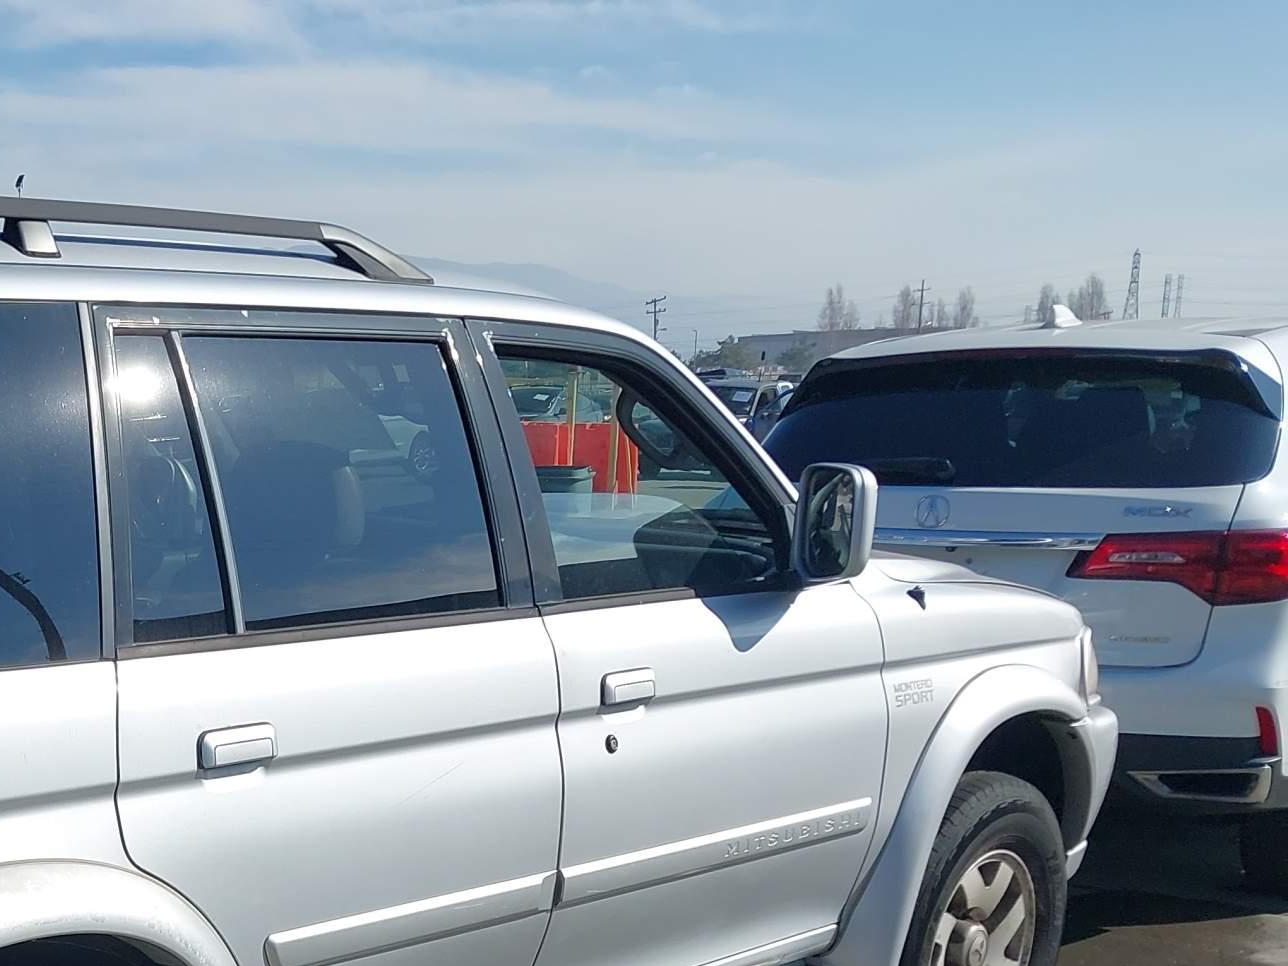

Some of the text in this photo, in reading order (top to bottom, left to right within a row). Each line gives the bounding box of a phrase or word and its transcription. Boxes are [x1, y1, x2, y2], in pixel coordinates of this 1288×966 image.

[893, 679, 934, 693] MONTERO
[895, 690, 934, 708] SPORT
[723, 812, 862, 858] MITSUBISHI
